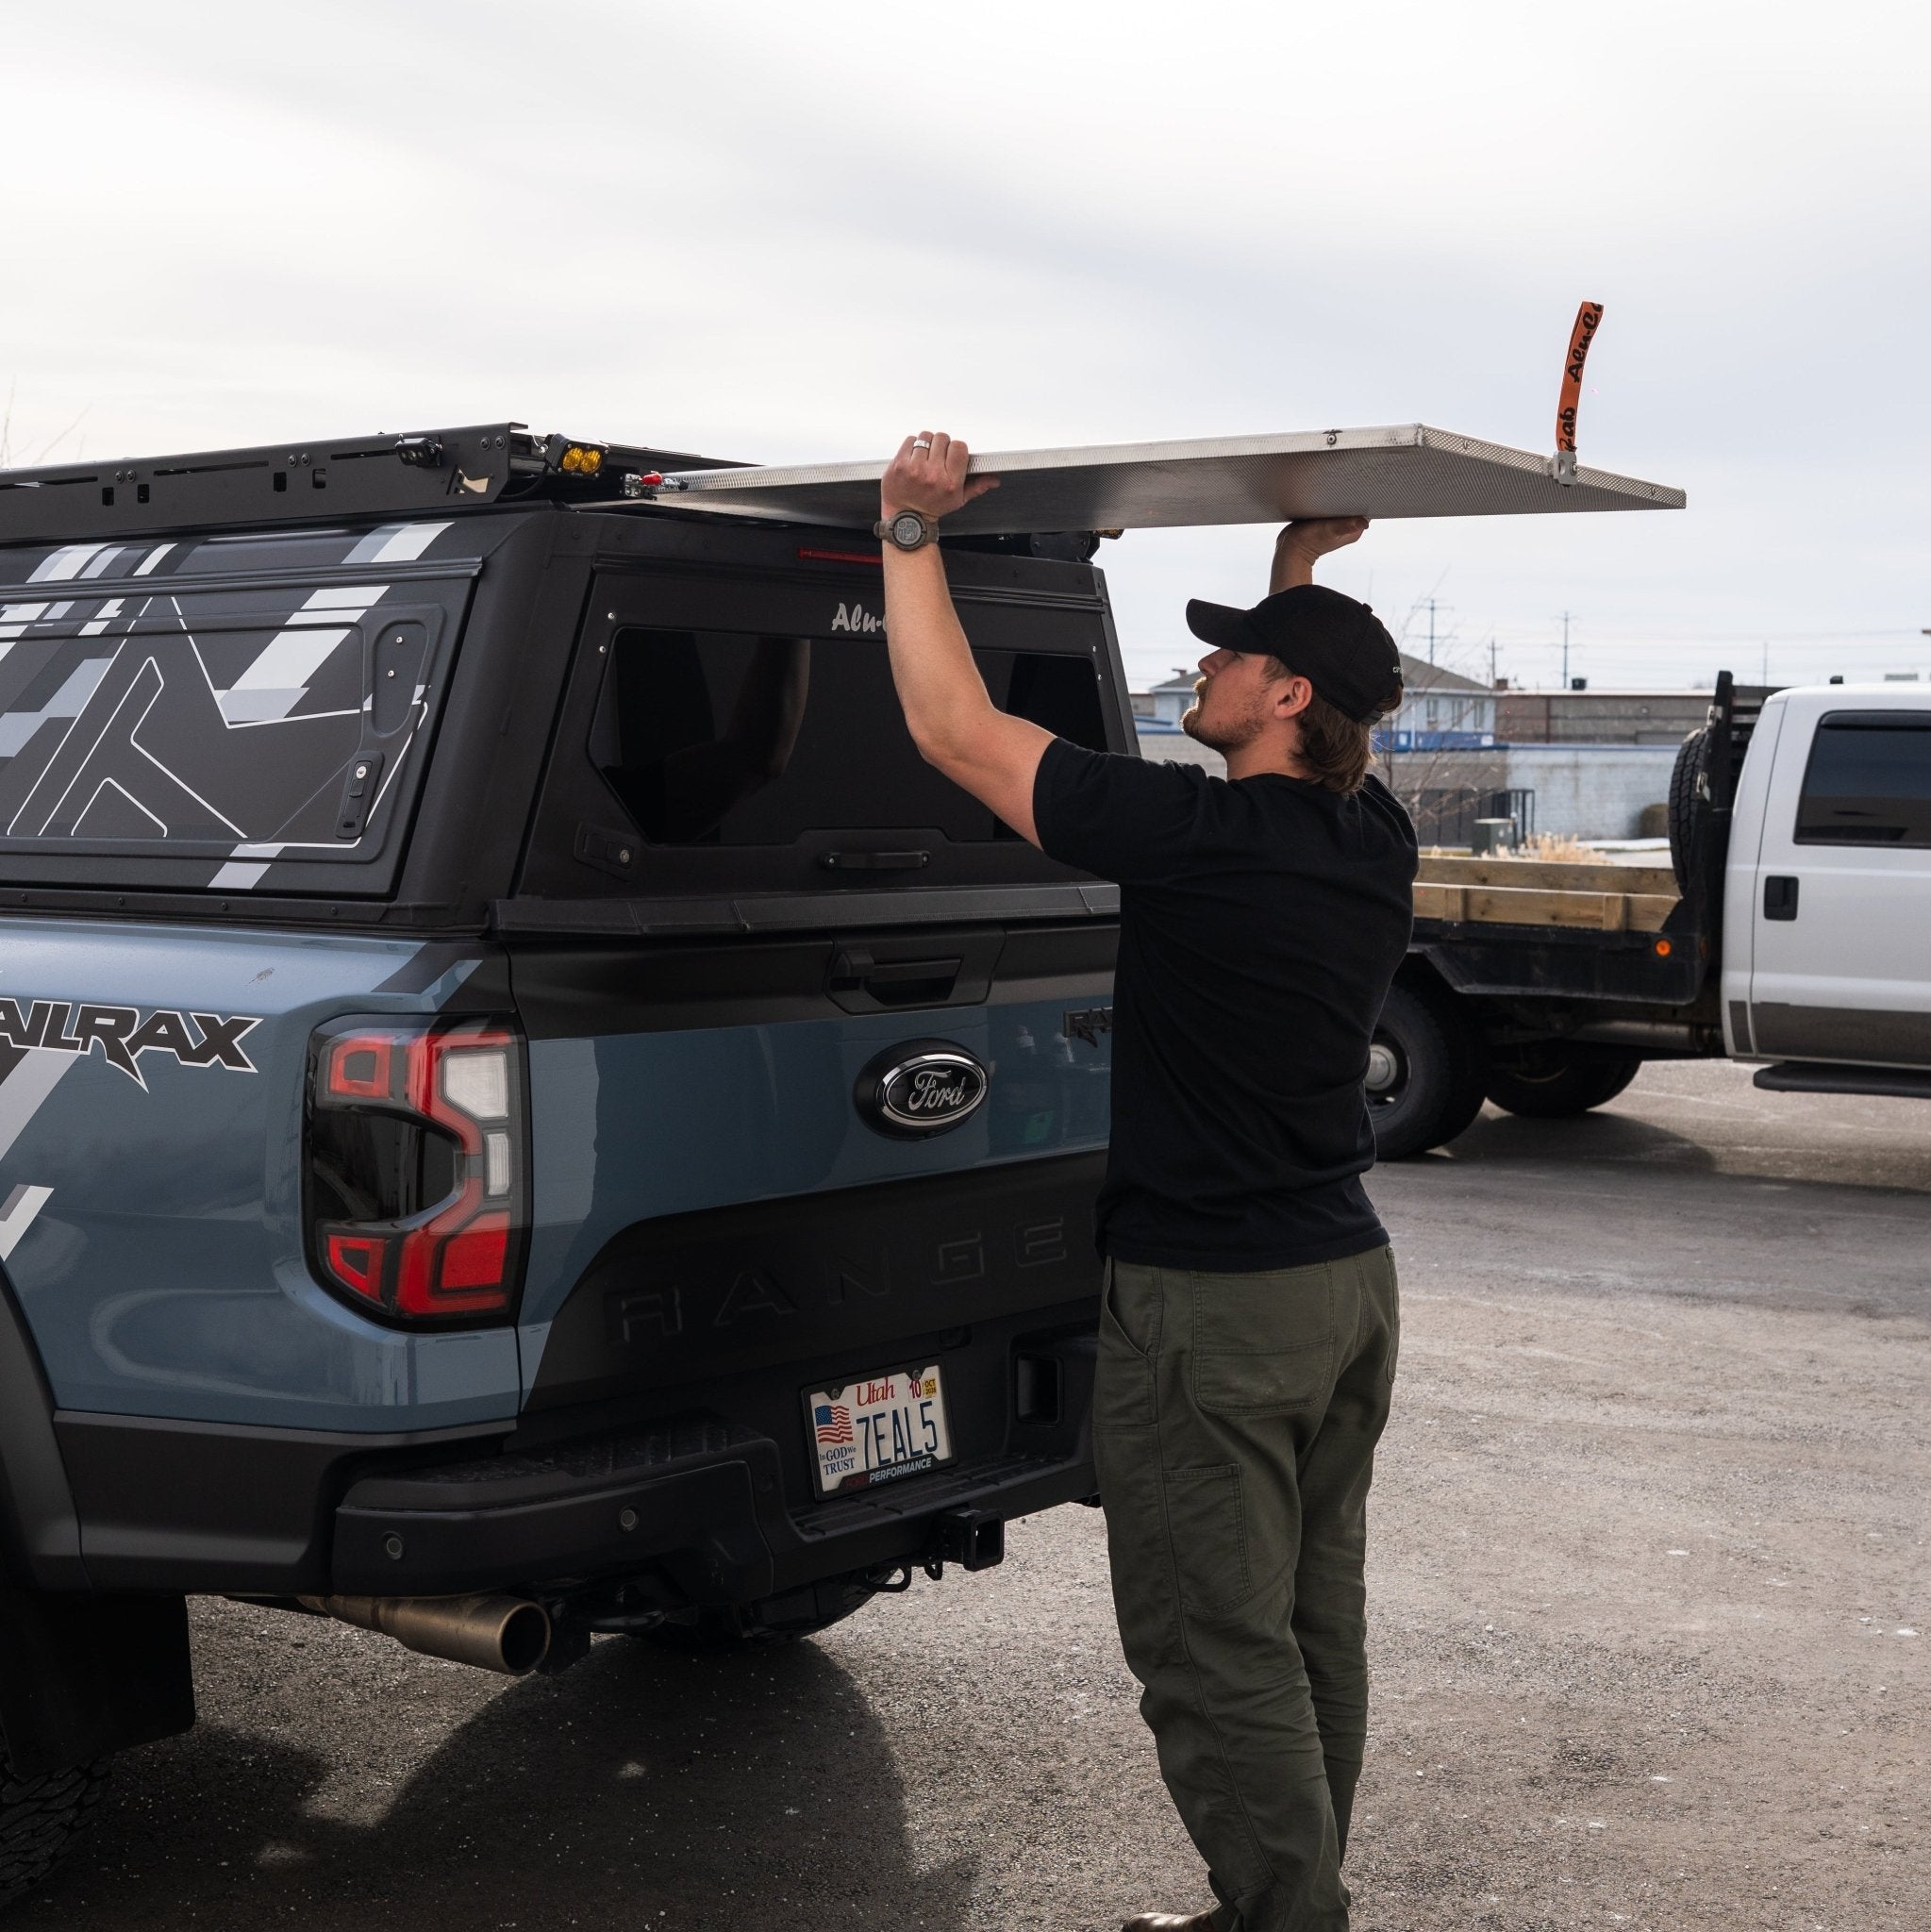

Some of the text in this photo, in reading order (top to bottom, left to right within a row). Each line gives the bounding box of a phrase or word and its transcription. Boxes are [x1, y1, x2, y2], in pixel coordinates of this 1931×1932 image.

[831, 602, 887, 633] Alu-
[1063, 1006, 1114, 1048] RA
[907, 1069, 967, 1111] Ford
[606, 1214, 1074, 1345] RANGE
[856, 1376, 895, 1407] Utah
[909, 1380, 922, 1399] 10
[924, 1378, 936, 1388] OCT
[857, 1401, 938, 1470] 7EAL5
[820, 1445, 857, 1462] In GOD We
[824, 1457, 856, 1475] TRUST
[869, 1457, 932, 1484] PERFORMANCE
